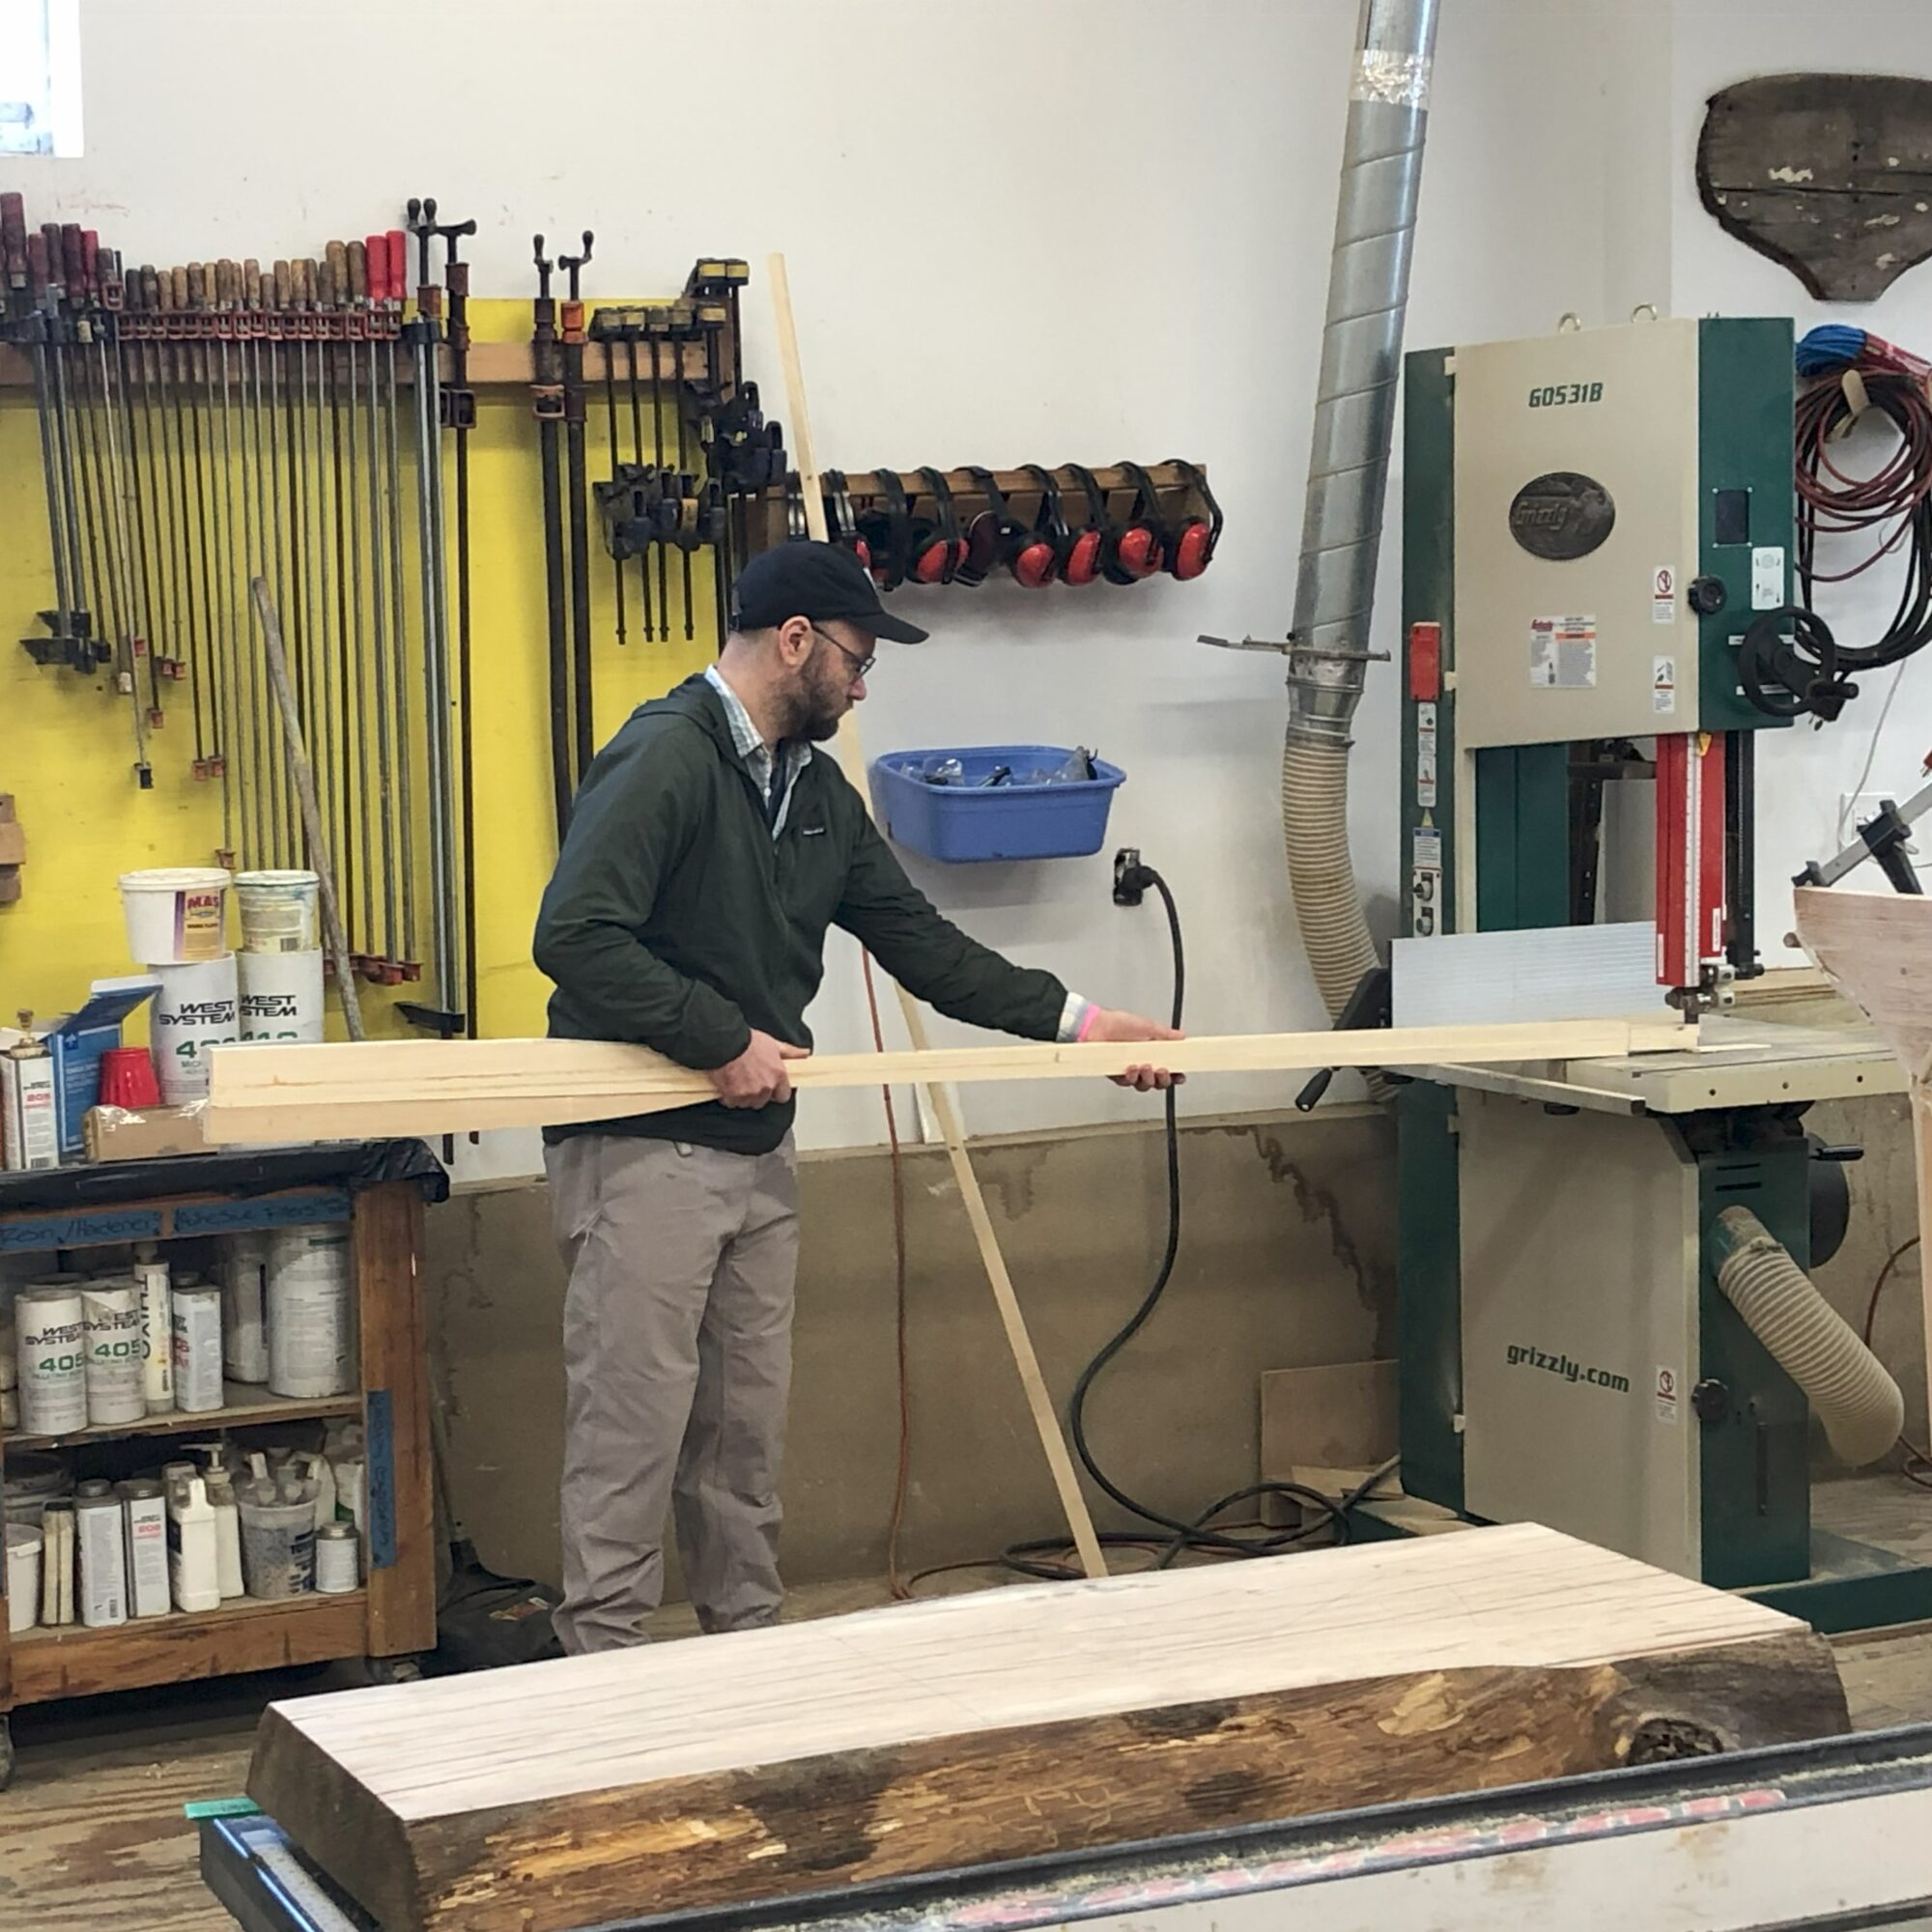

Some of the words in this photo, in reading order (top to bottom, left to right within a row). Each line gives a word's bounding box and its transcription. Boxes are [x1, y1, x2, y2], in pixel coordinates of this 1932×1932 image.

[181, 1001, 234, 1014] WEST
[159, 1011, 235, 1026] SYSTEM
[1507, 1345, 1630, 1393] grizzly.com
